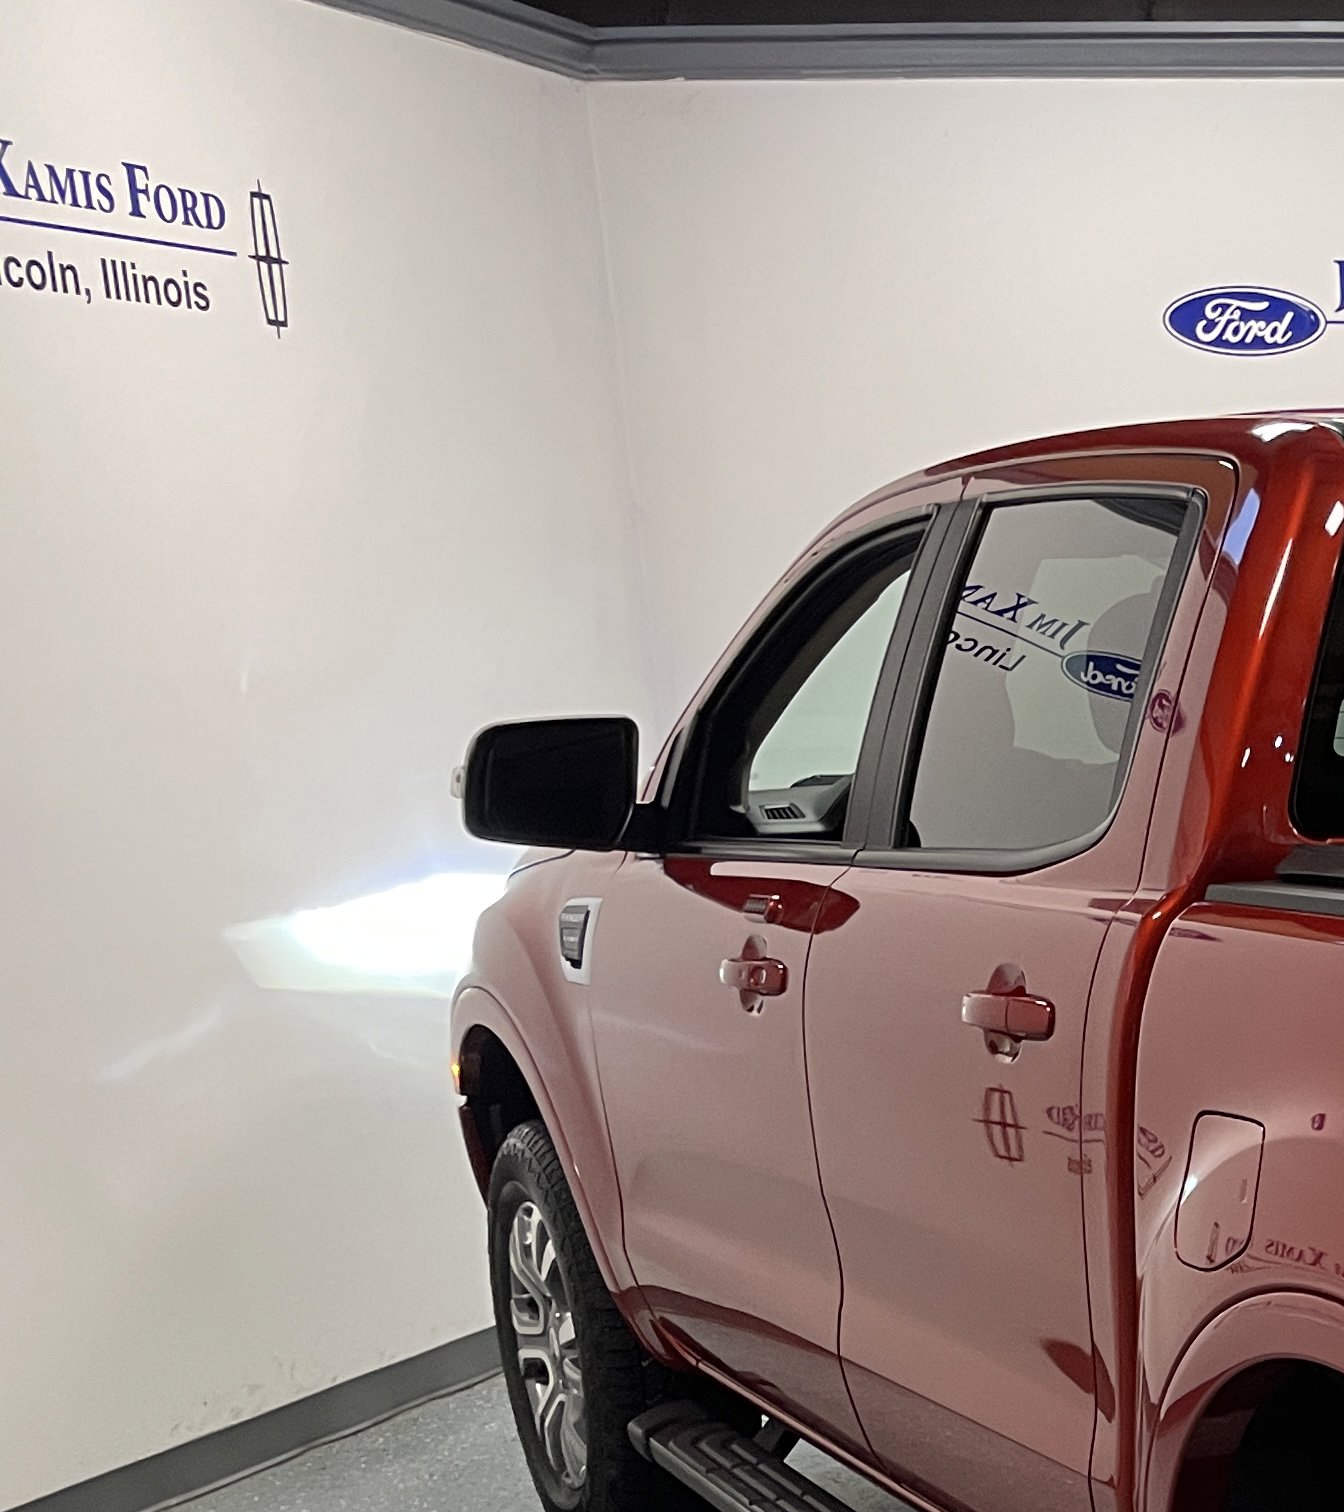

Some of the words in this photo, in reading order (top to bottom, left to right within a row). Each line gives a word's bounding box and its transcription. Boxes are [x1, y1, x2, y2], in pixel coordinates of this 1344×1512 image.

[120, 160, 227, 231] FORD
[100, 257, 211, 312] Illinois
[1195, 297, 1294, 346] Ford
